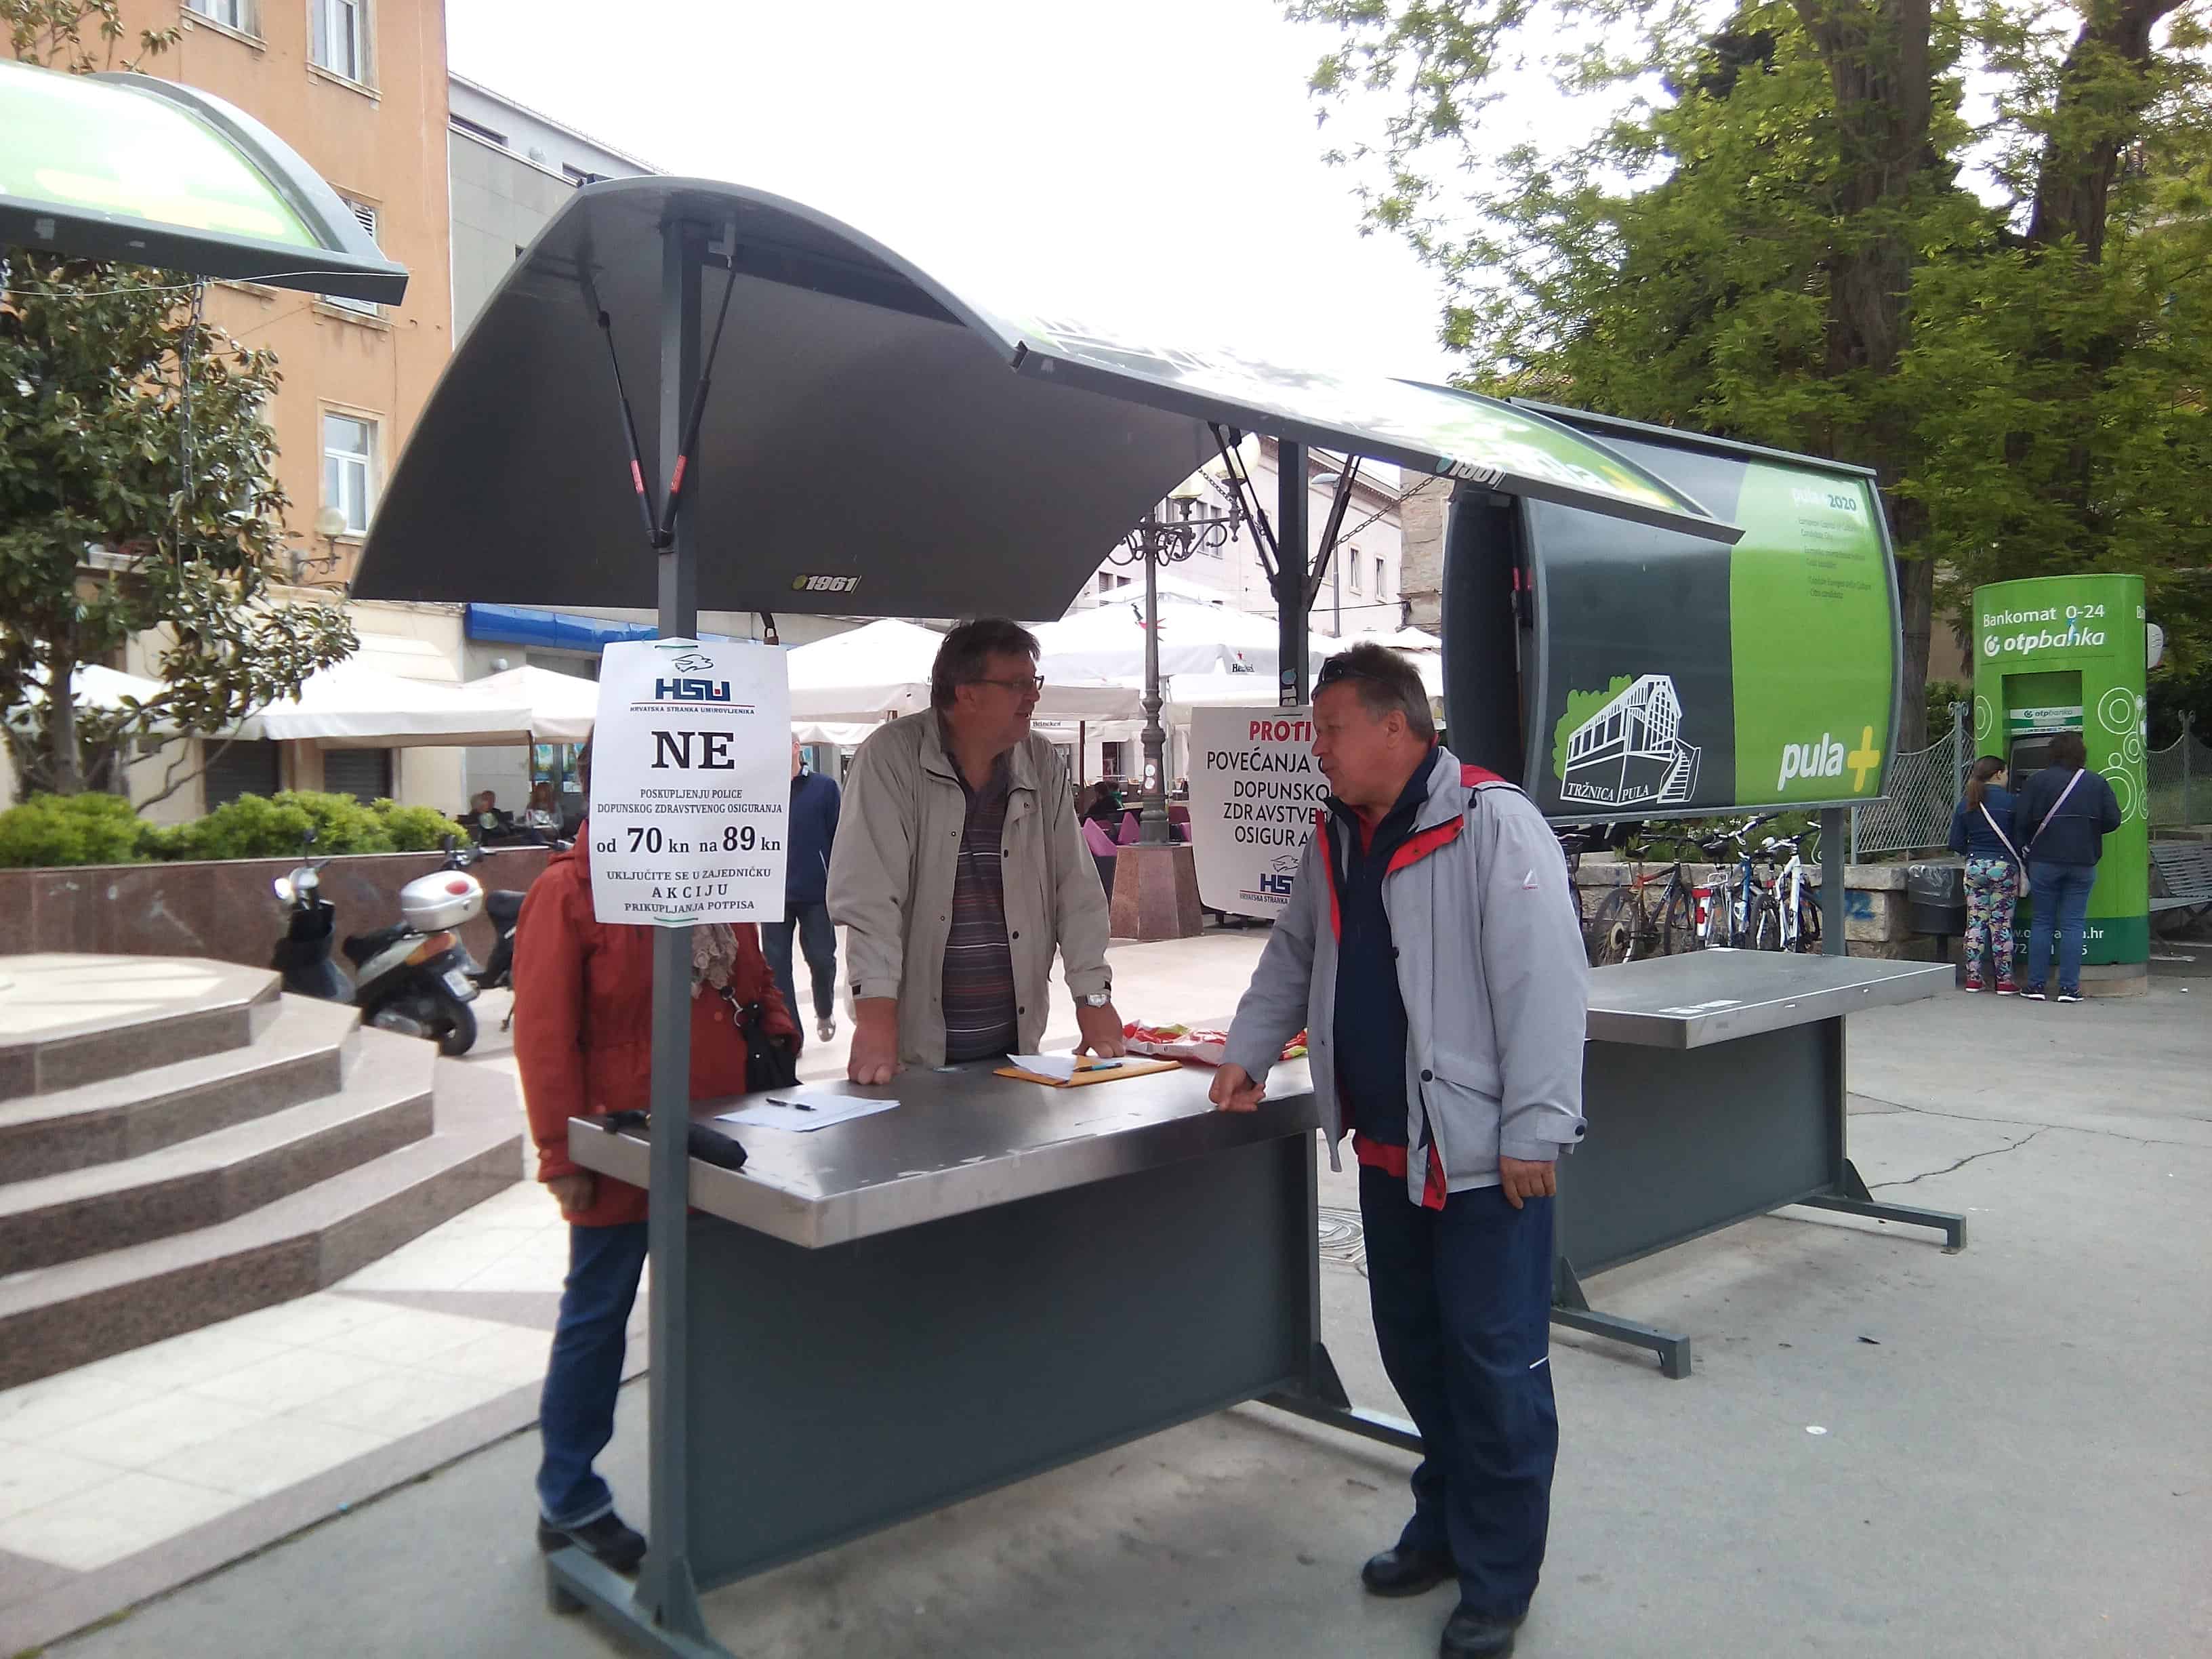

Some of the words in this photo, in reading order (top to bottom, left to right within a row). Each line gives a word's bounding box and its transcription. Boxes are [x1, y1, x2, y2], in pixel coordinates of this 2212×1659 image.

[1828, 494, 1857, 511] 2020
[1984, 608, 2057, 628] Bankomat
[2066, 604, 2104, 619] 0-24
[655, 678, 731, 701] HSU
[700, 707, 755, 715] UMIROVLJENIKA
[1249, 720, 1312, 742] PROTI
[651, 731, 735, 769] NE
[1207, 746, 1311, 773] POVEĆANJA
[640, 789, 710, 798] POSKUPLJENJU
[712, 790, 743, 798] POLICE
[1233, 780, 1330, 802] DOPUNSKO
[1567, 781, 1615, 802] TRŽNICA
[1621, 784, 1650, 801] PULA
[598, 804, 652, 813] DOPUNSKOG
[655, 804, 725, 813] ZDRAVSTVENOG
[727, 804, 782, 813] OSIGURANJA
[1223, 802, 1317, 825] ZDRAVSTVE
[596, 838, 617, 853] od
[627, 827, 662, 853] 70
[668, 839, 690, 853] kn
[699, 840, 718, 853] na
[722, 826, 756, 852] 89
[760, 837, 781, 851] kn
[1234, 825, 1309, 847] OSIGURA
[607, 869, 672, 880] UKLJUČITE
[675, 872, 689, 880] SE
[693, 871, 699, 879] U
[702, 867, 771, 879] ZAJEDNIČKU
[1260, 873, 1294, 895] HS
[652, 883, 728, 899] AKCIJU
[1263, 895, 1288, 905] STRANKA
[624, 903, 705, 914] PRIKUPLJANJA
[708, 901, 754, 910] POTPISA
